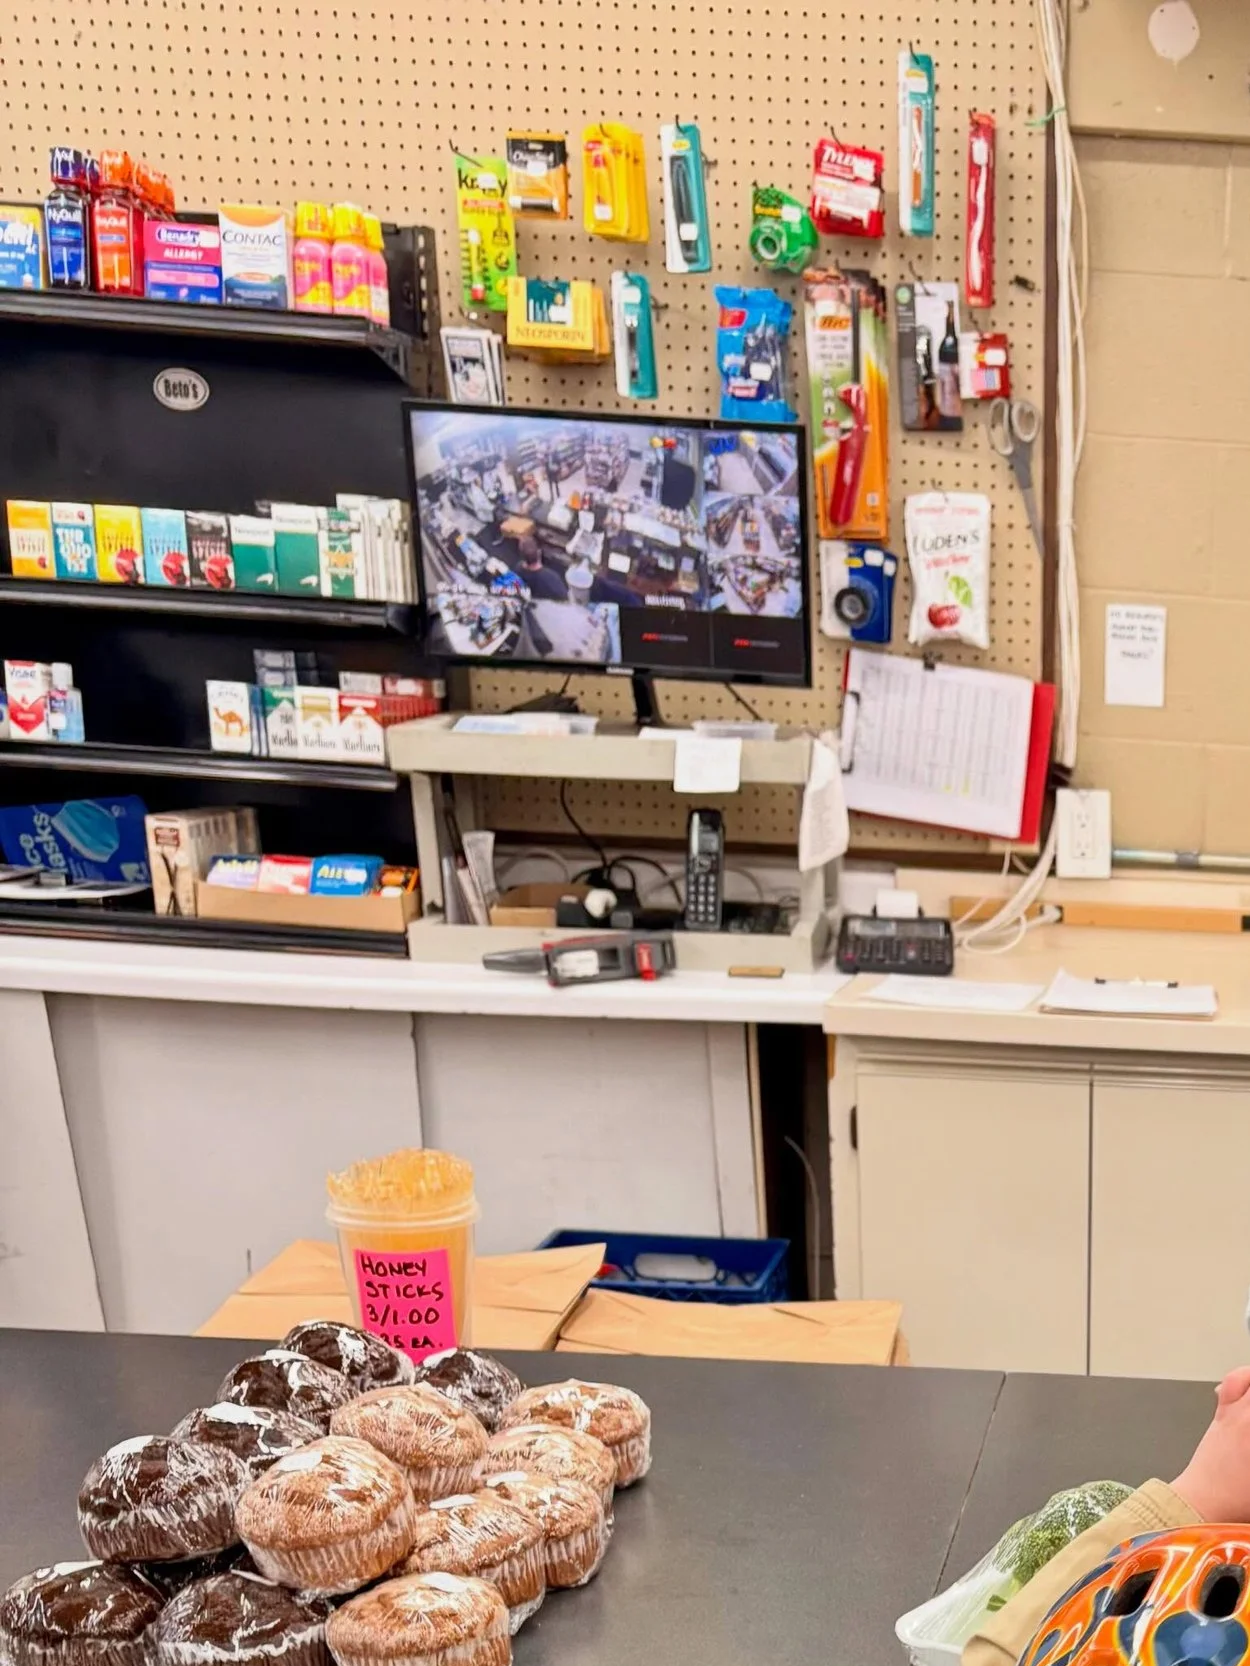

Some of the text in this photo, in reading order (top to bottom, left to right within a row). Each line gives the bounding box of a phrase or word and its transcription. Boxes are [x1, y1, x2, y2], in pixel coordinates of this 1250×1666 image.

[222, 229, 282, 247] CONTAC
[163, 377, 200, 401] Beto's
[360, 1253, 427, 1277] HONEY
[365, 1281, 444, 1301] STICKS
[366, 1304, 440, 1326] 3/1.00
